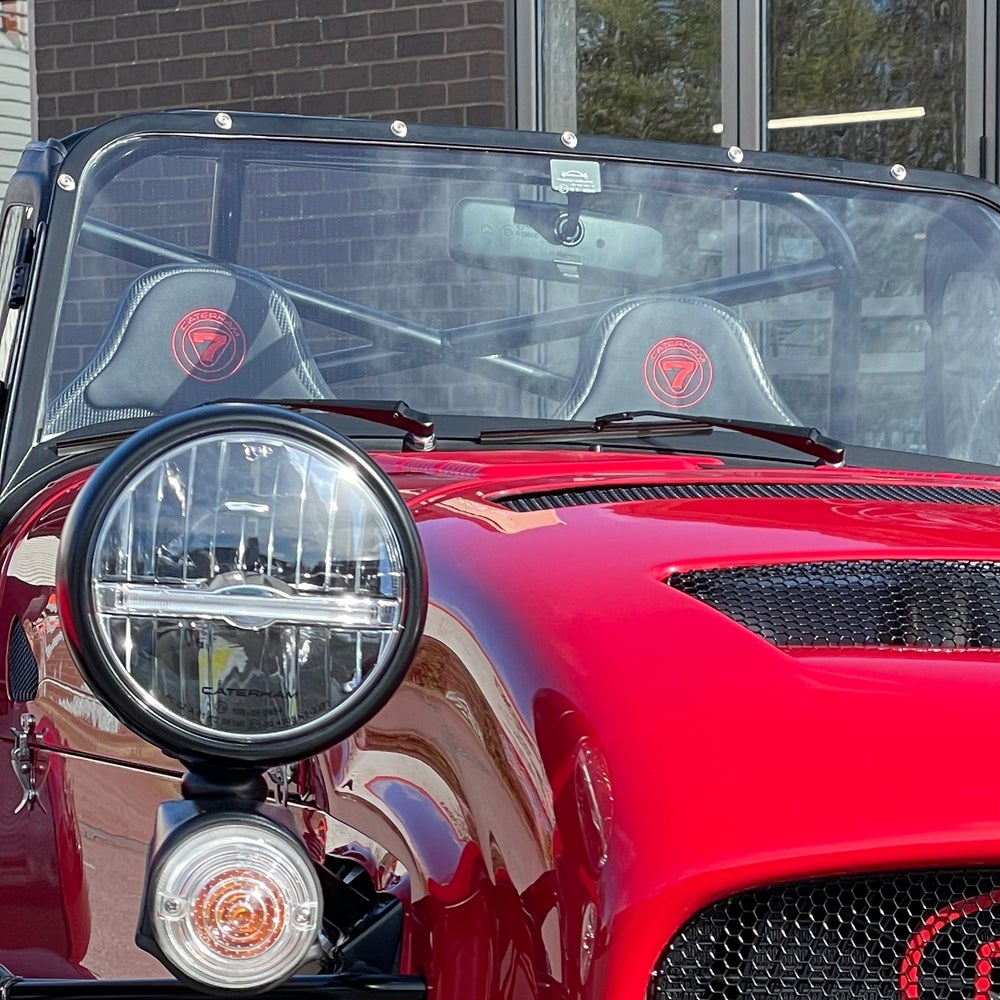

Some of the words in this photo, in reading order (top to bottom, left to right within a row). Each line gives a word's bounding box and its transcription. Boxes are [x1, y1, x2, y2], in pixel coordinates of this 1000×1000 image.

[180, 311, 240, 337] CATERHAM
[193, 331, 228, 362] 7
[650, 340, 706, 362] CATERHAM
[662, 360, 695, 388] 7
[201, 686, 298, 698] CATERHAM
